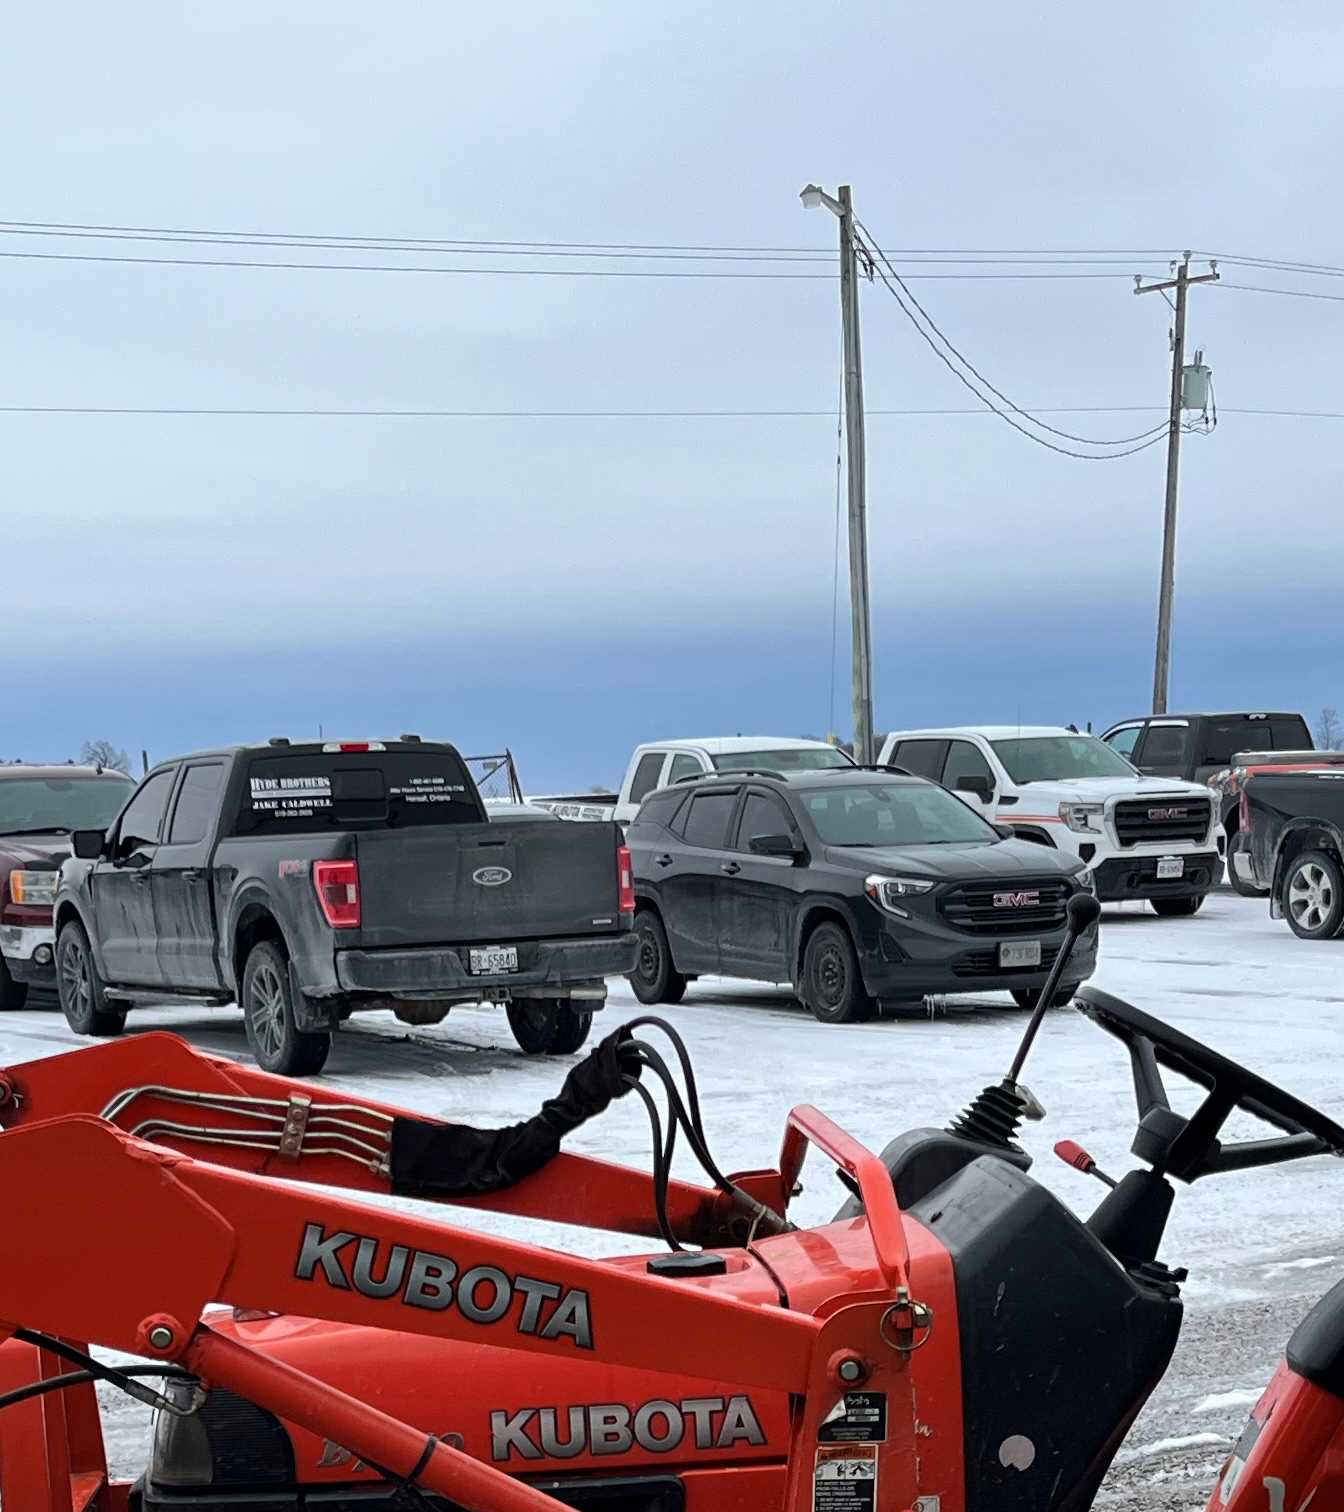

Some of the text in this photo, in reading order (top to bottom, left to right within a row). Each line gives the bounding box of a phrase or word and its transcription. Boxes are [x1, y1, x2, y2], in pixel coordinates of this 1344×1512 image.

[280, 777, 331, 789] BROTHERS
[252, 799, 334, 810] JAKE CALDWELL
[1147, 807, 1188, 820] GMC
[993, 891, 1040, 908] GMC
[295, 1221, 595, 1350] KUBOTA
[490, 1395, 768, 1461] KUBOTA
